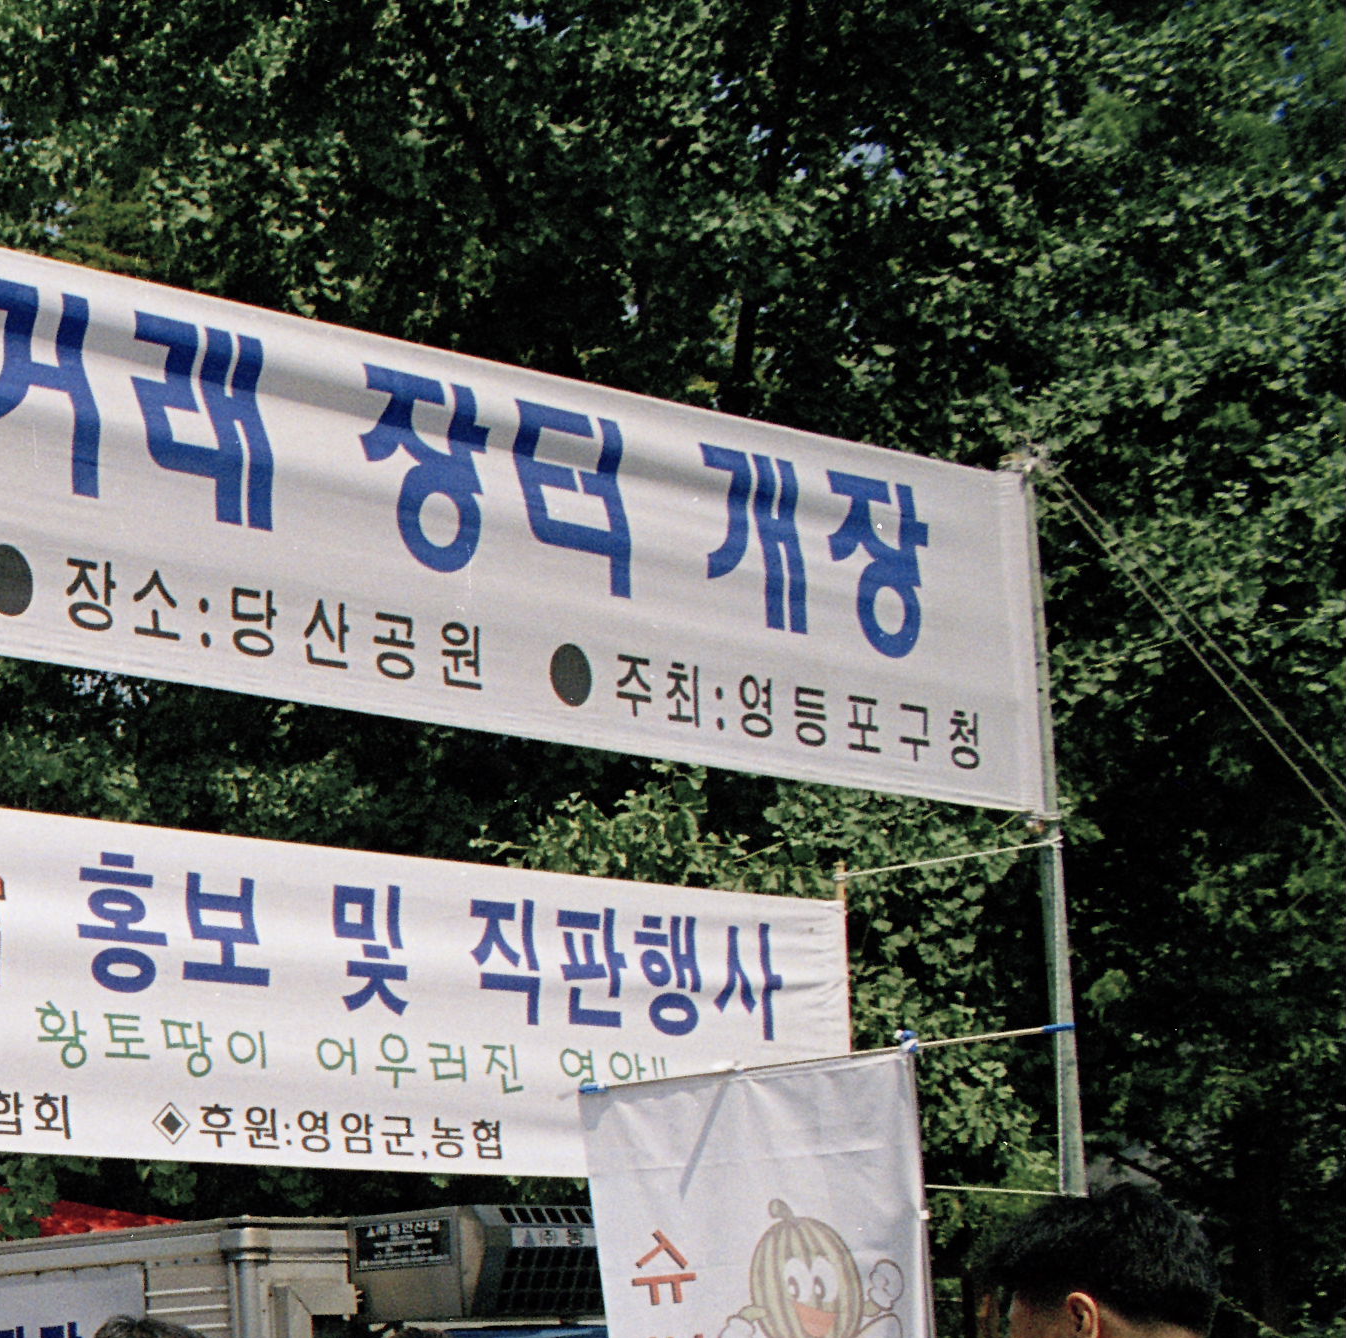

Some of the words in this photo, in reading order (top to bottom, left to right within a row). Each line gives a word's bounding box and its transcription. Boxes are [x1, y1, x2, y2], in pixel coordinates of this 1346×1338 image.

[359, 362, 633, 598] 장터
[700, 442, 930, 658] 개장
[65, 557, 484, 692] 장소:당산공원
[615, 653, 982, 770] 주최:영등포구청
[76, 851, 272, 993] 홍보
[332, 884, 409, 1016] 및
[469, 898, 785, 1041] 직판행사
[35, 1001, 268, 1078] 황토땅이
[316, 1032, 525, 1094] 어우러진
